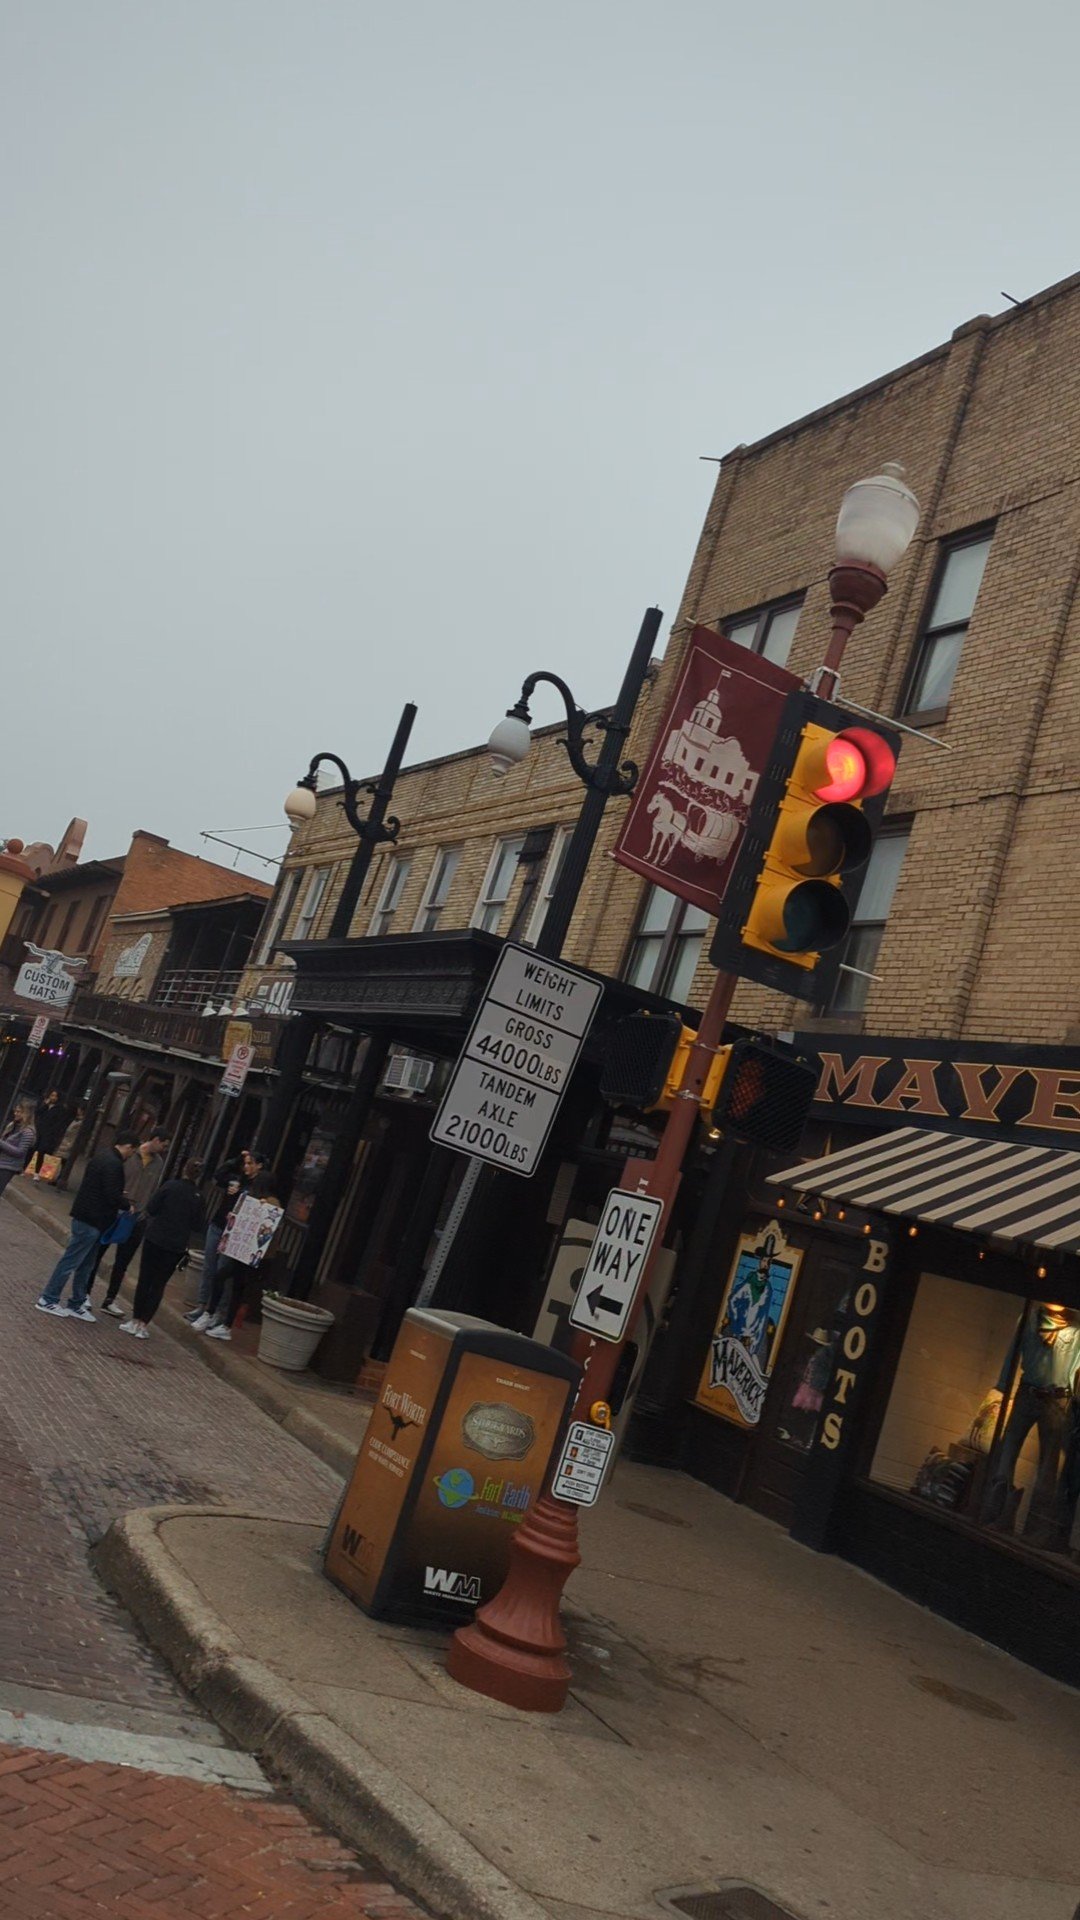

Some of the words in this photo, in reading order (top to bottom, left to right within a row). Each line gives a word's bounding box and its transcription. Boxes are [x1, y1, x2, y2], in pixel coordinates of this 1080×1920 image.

[24, 969, 71, 991] CUSTOM
[28, 983, 57, 1000] HATS
[523, 962, 578, 997] WEIGHT
[515, 988, 564, 1021] LIMITS
[505, 1017, 554, 1049] GROSS
[479, 1071, 537, 1108] TANDEM
[477, 1100, 518, 1128] AXLE
[606, 1206, 651, 1245] ONE
[593, 1241, 640, 1282] WAY
[820, 1238, 889, 1450] BOOTS
[400, 1393, 427, 1425] WORTH
[501, 1481, 531, 1511] Earth
[424, 1566, 482, 1599] WM
